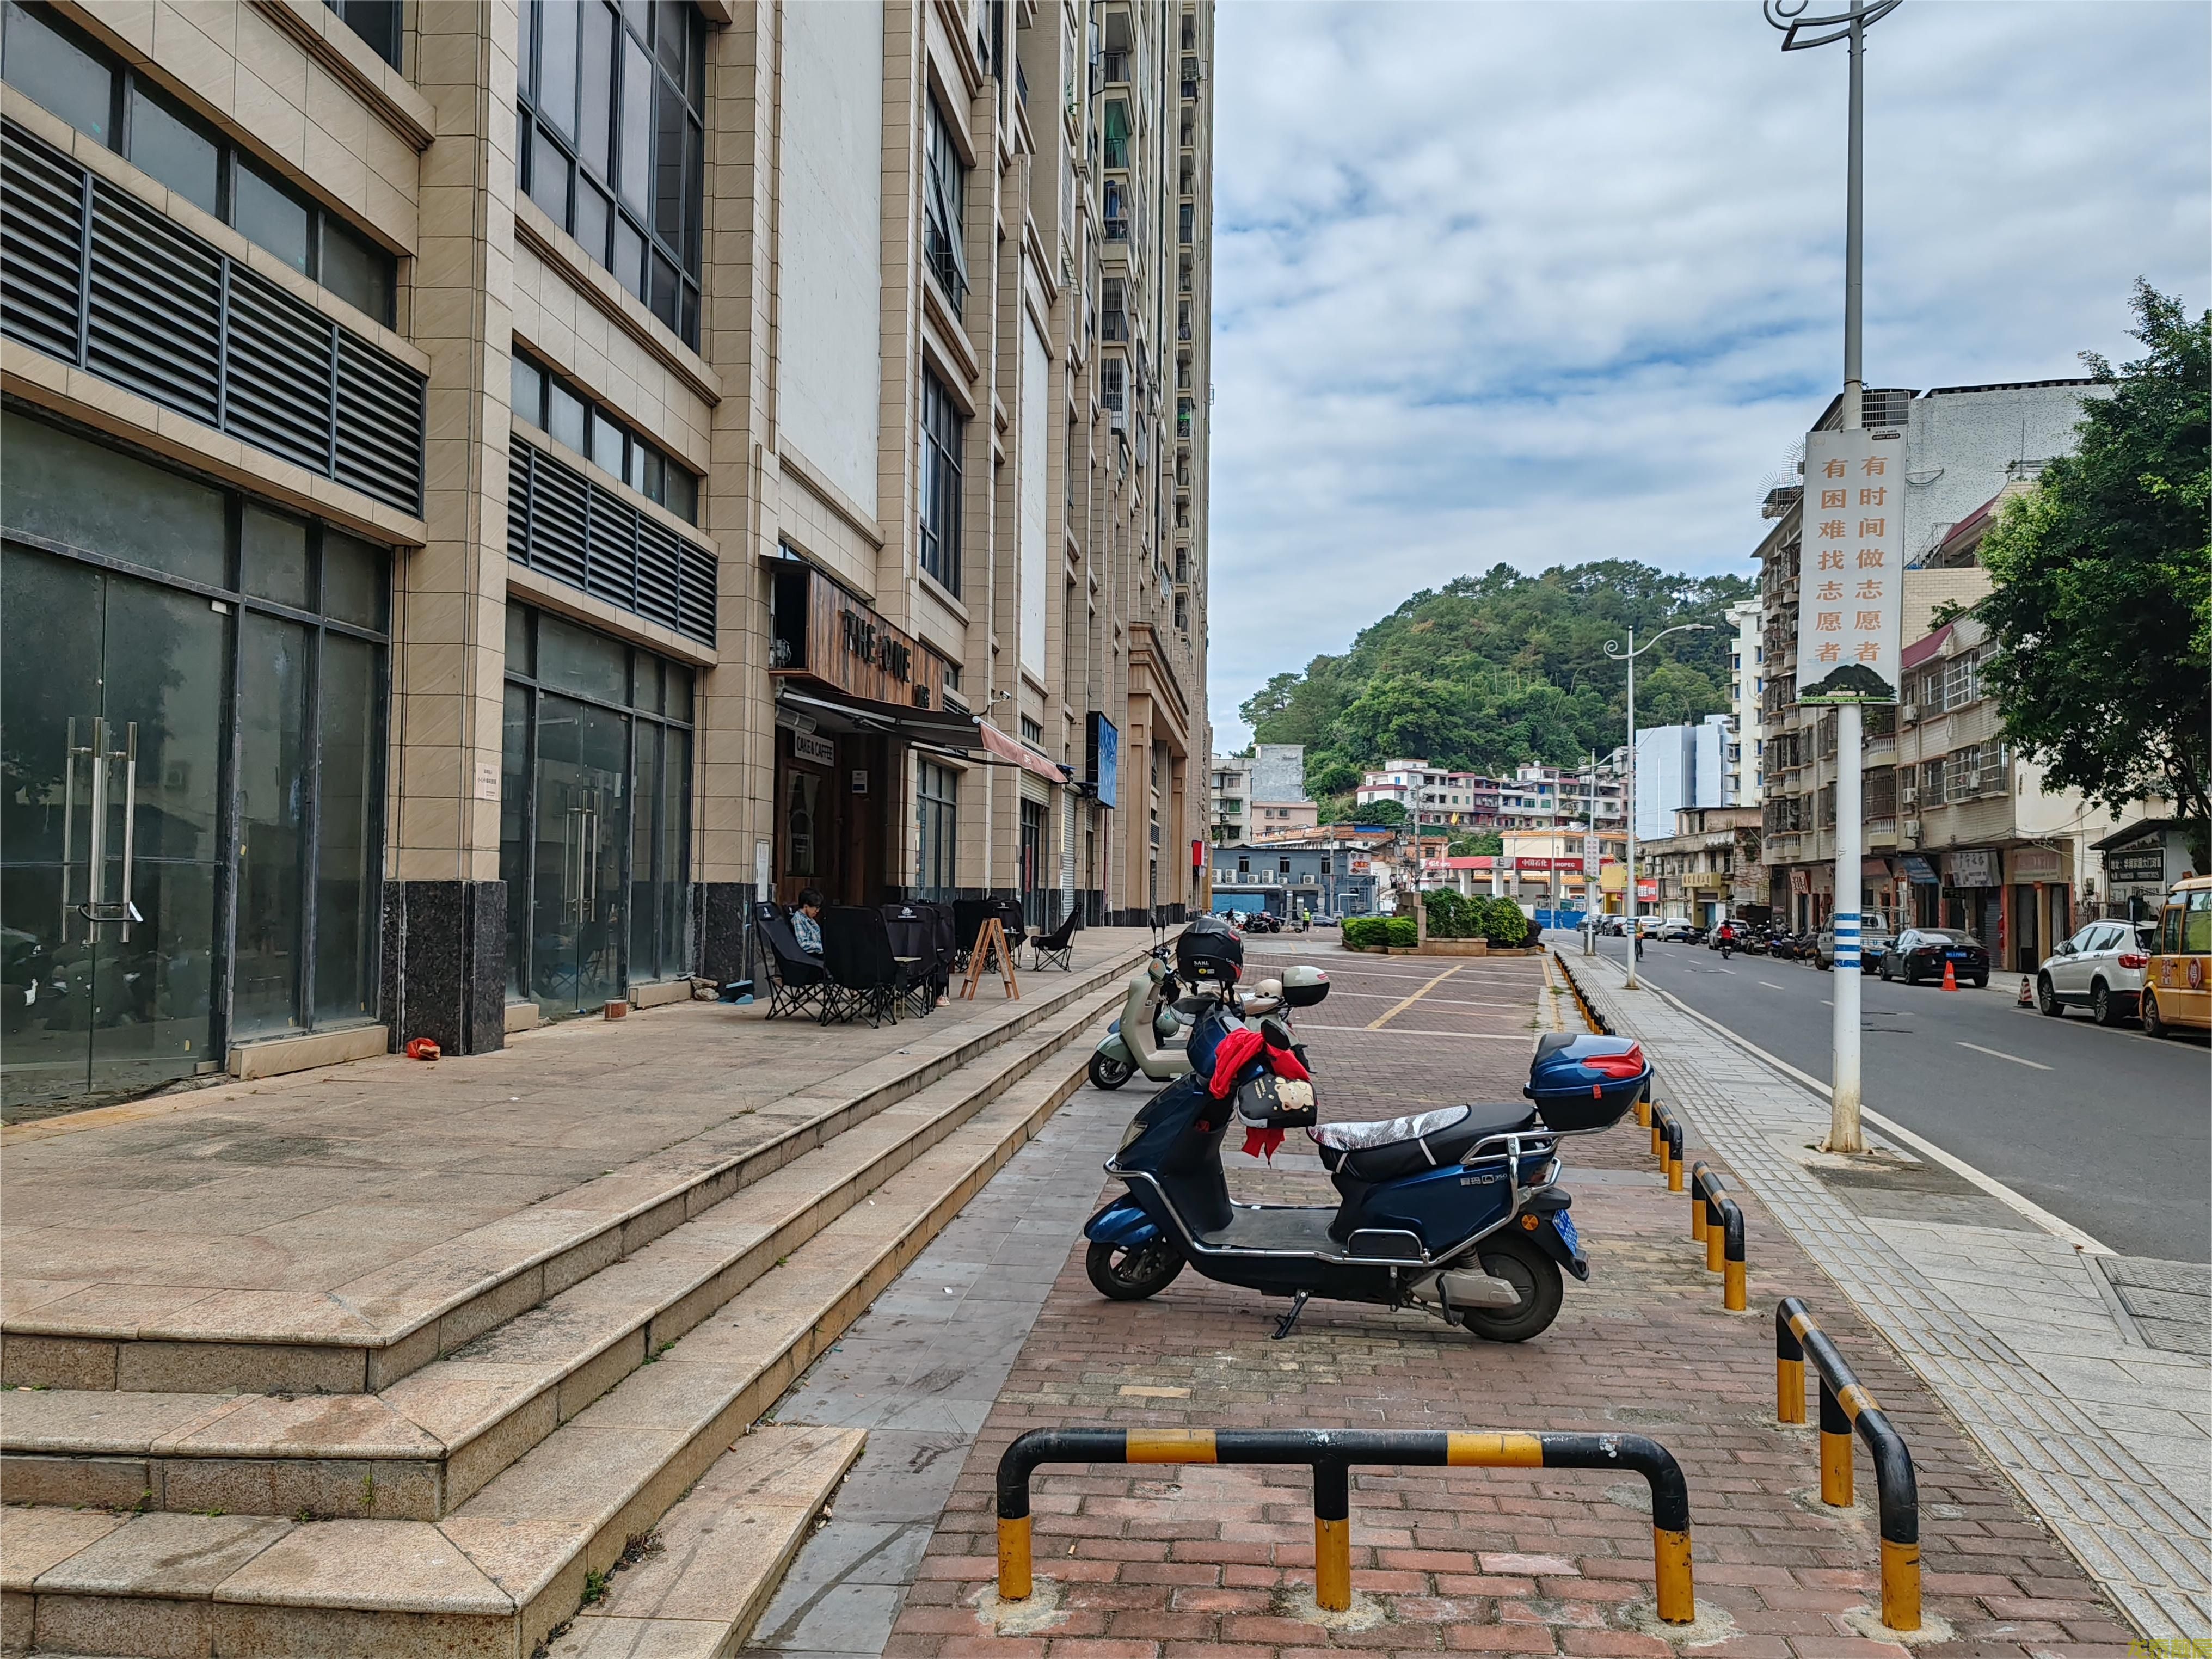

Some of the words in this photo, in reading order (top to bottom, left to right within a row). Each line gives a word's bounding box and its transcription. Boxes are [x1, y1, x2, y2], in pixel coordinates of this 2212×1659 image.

[1814, 458, 1849, 662] 有困难找志愿者
[1853, 456, 1888, 662] 有时间做志愿者
[845, 609, 876, 663] THE
[882, 635, 911, 683] ONE
[1522, 859, 1547, 867] 中国石化
